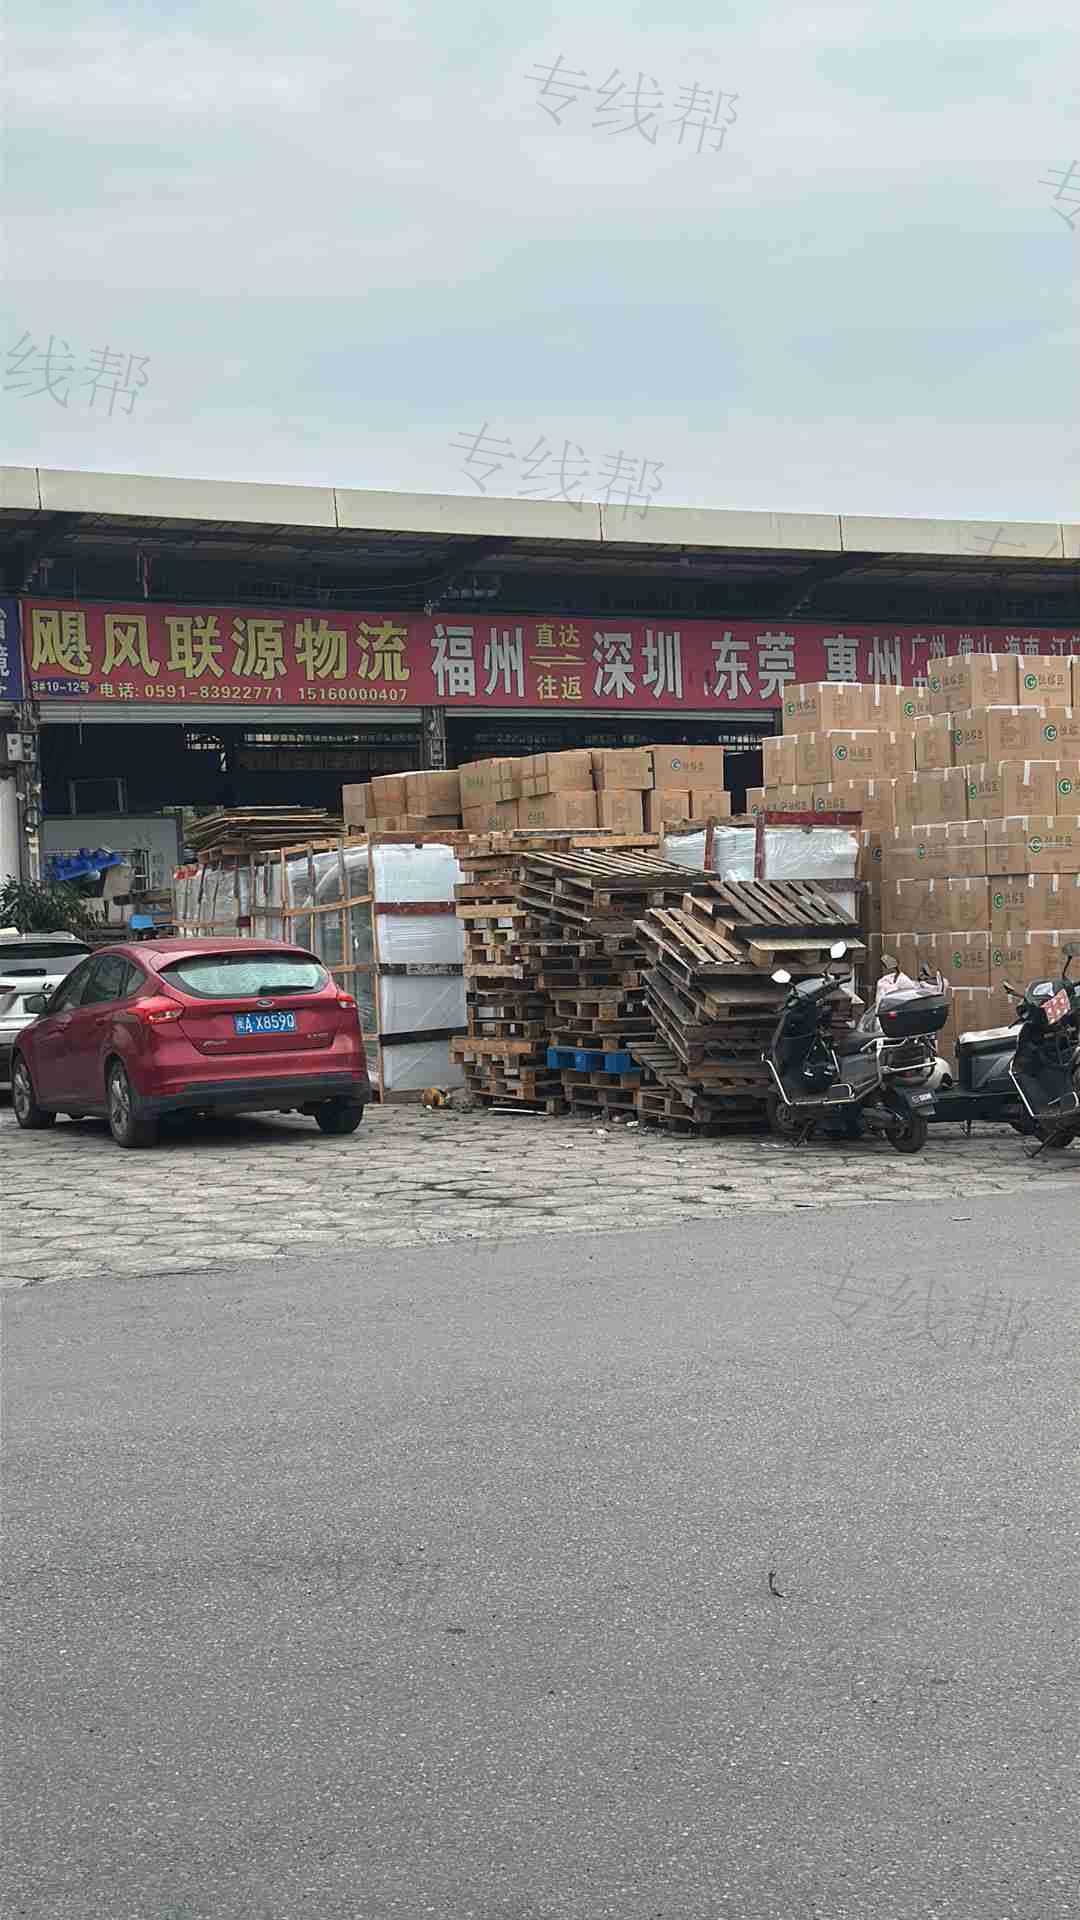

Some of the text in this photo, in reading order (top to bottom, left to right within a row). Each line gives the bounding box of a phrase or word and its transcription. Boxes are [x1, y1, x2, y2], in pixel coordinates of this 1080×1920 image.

[31, 609, 410, 682] 飓风联源物流
[535, 624, 581, 648] 直达
[431, 623, 525, 697] 福州
[593, 630, 683, 699] 深圳
[711, 632, 796, 700] 东莞
[144, 684, 283, 699] 0591-83922771
[298, 687, 408, 701] 15160000407
[536, 676, 583, 700] 往返
